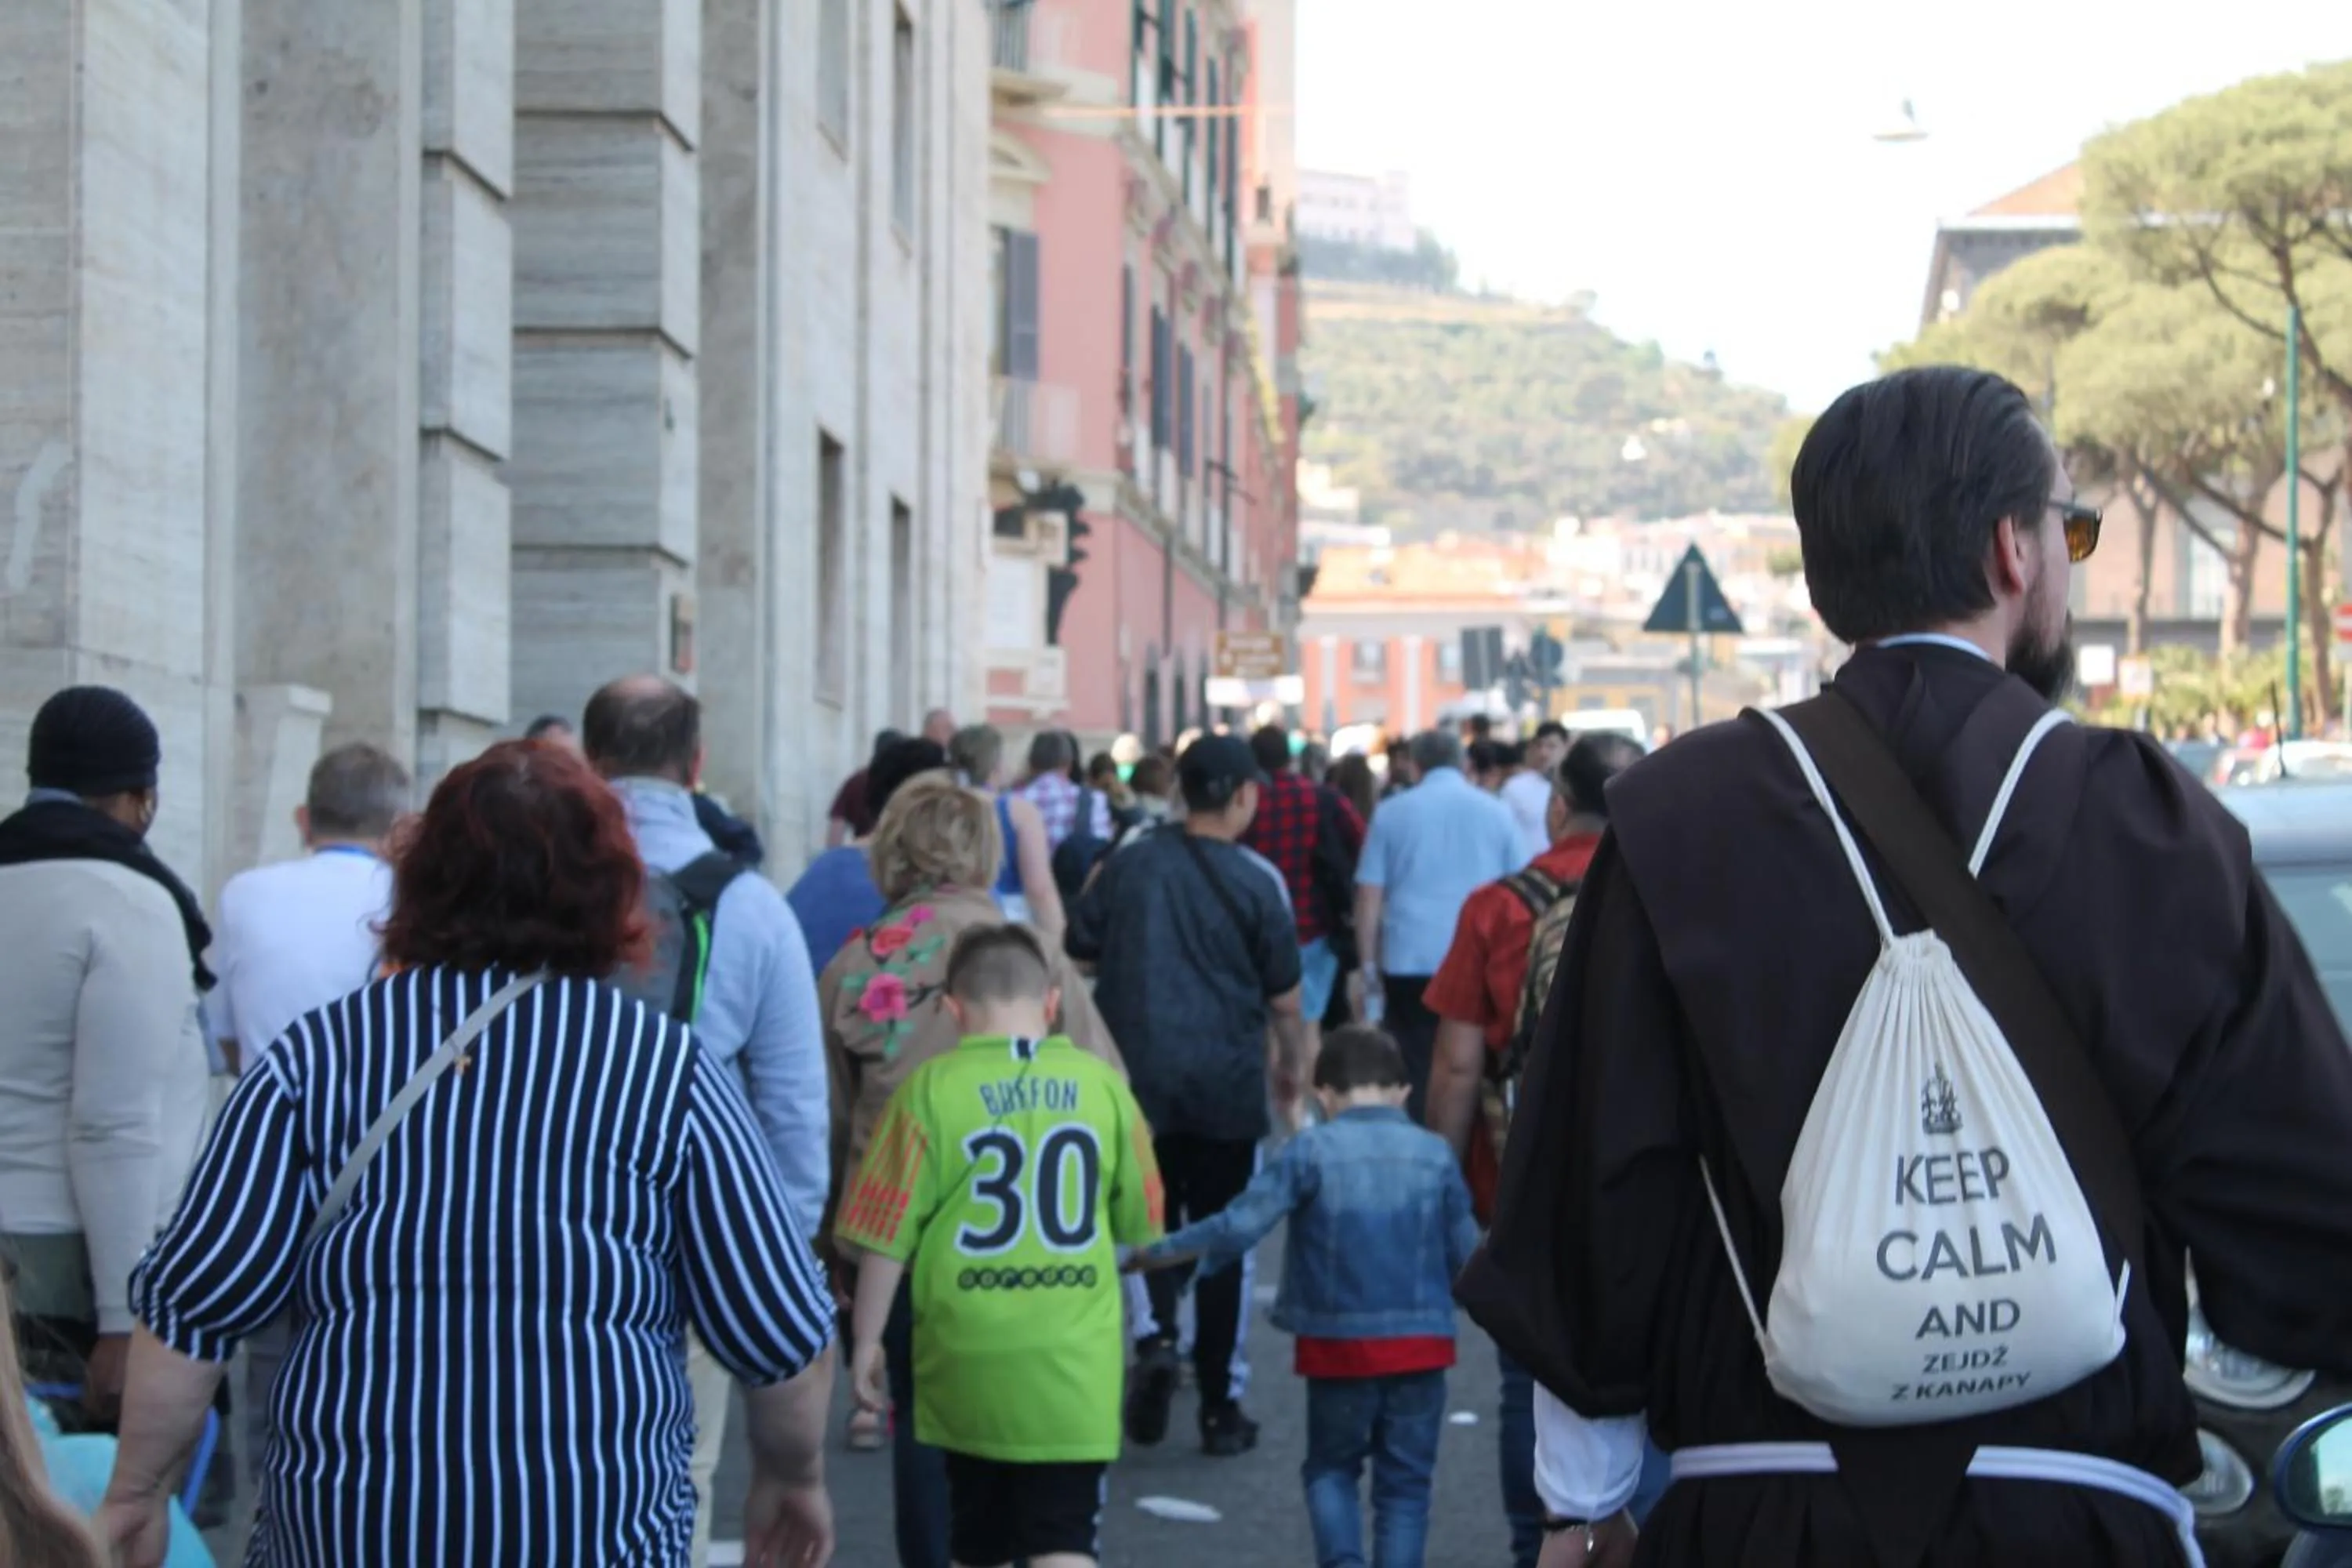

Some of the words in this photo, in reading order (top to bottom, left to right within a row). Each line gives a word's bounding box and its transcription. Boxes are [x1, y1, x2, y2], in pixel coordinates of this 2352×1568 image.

[978, 1076, 1078, 1116] BUFFON
[956, 1123, 1098, 1255] 30
[1896, 1145, 2009, 1205] KEEP
[1877, 1212, 2056, 1281] CALM
[1915, 1298, 2020, 1339] AND
[1890, 1382, 1910, 1401] Z
[1915, 1370, 2032, 1400] KANAPY
